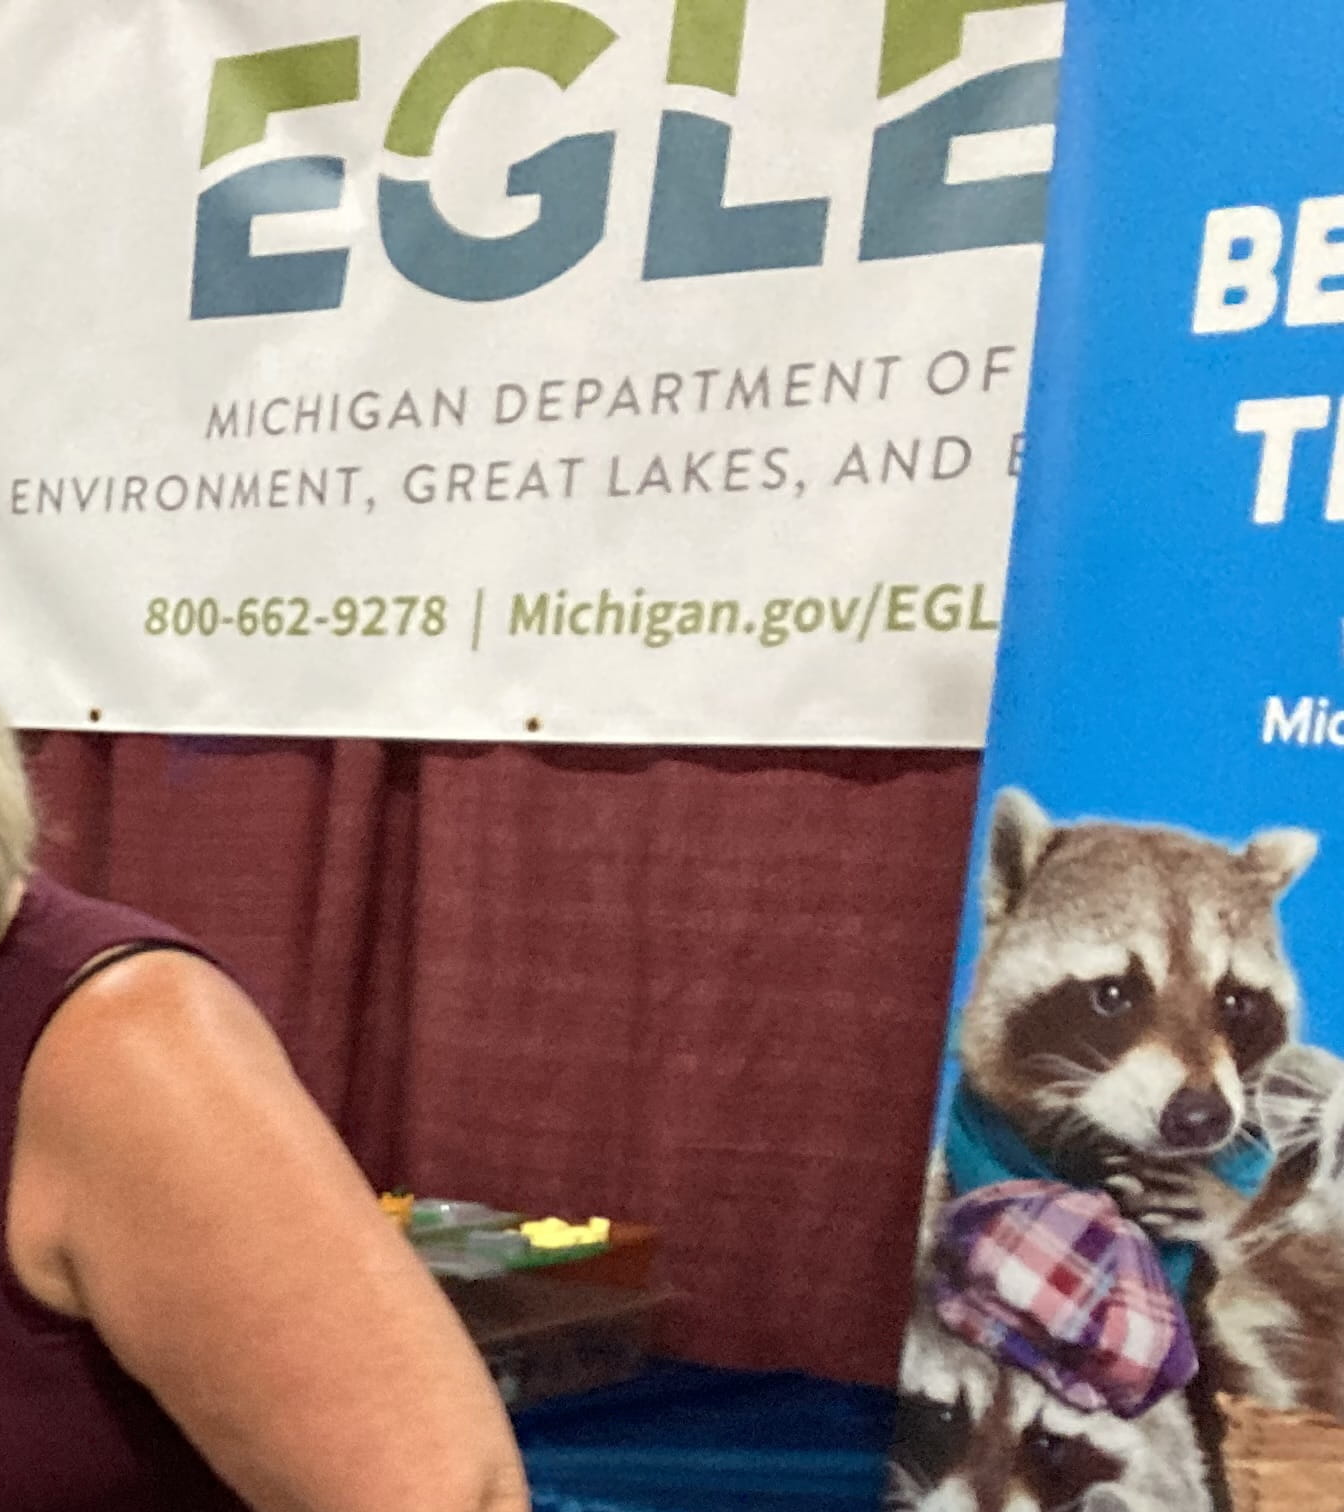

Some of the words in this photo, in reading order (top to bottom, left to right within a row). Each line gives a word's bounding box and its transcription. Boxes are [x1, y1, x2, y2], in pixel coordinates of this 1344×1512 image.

[189, 0, 1065, 320] EGLE
[205, 386, 467, 440] MICHIGAN
[494, 355, 902, 424] DEPARTMENT
[926, 346, 1017, 396] OF
[11, 465, 375, 514] ENVIRONMENT,
[402, 457, 585, 504] GREAT
[606, 446, 807, 499] LAKES,
[832, 434, 973, 486] AND
[144, 595, 448, 638] 800-662-9278
